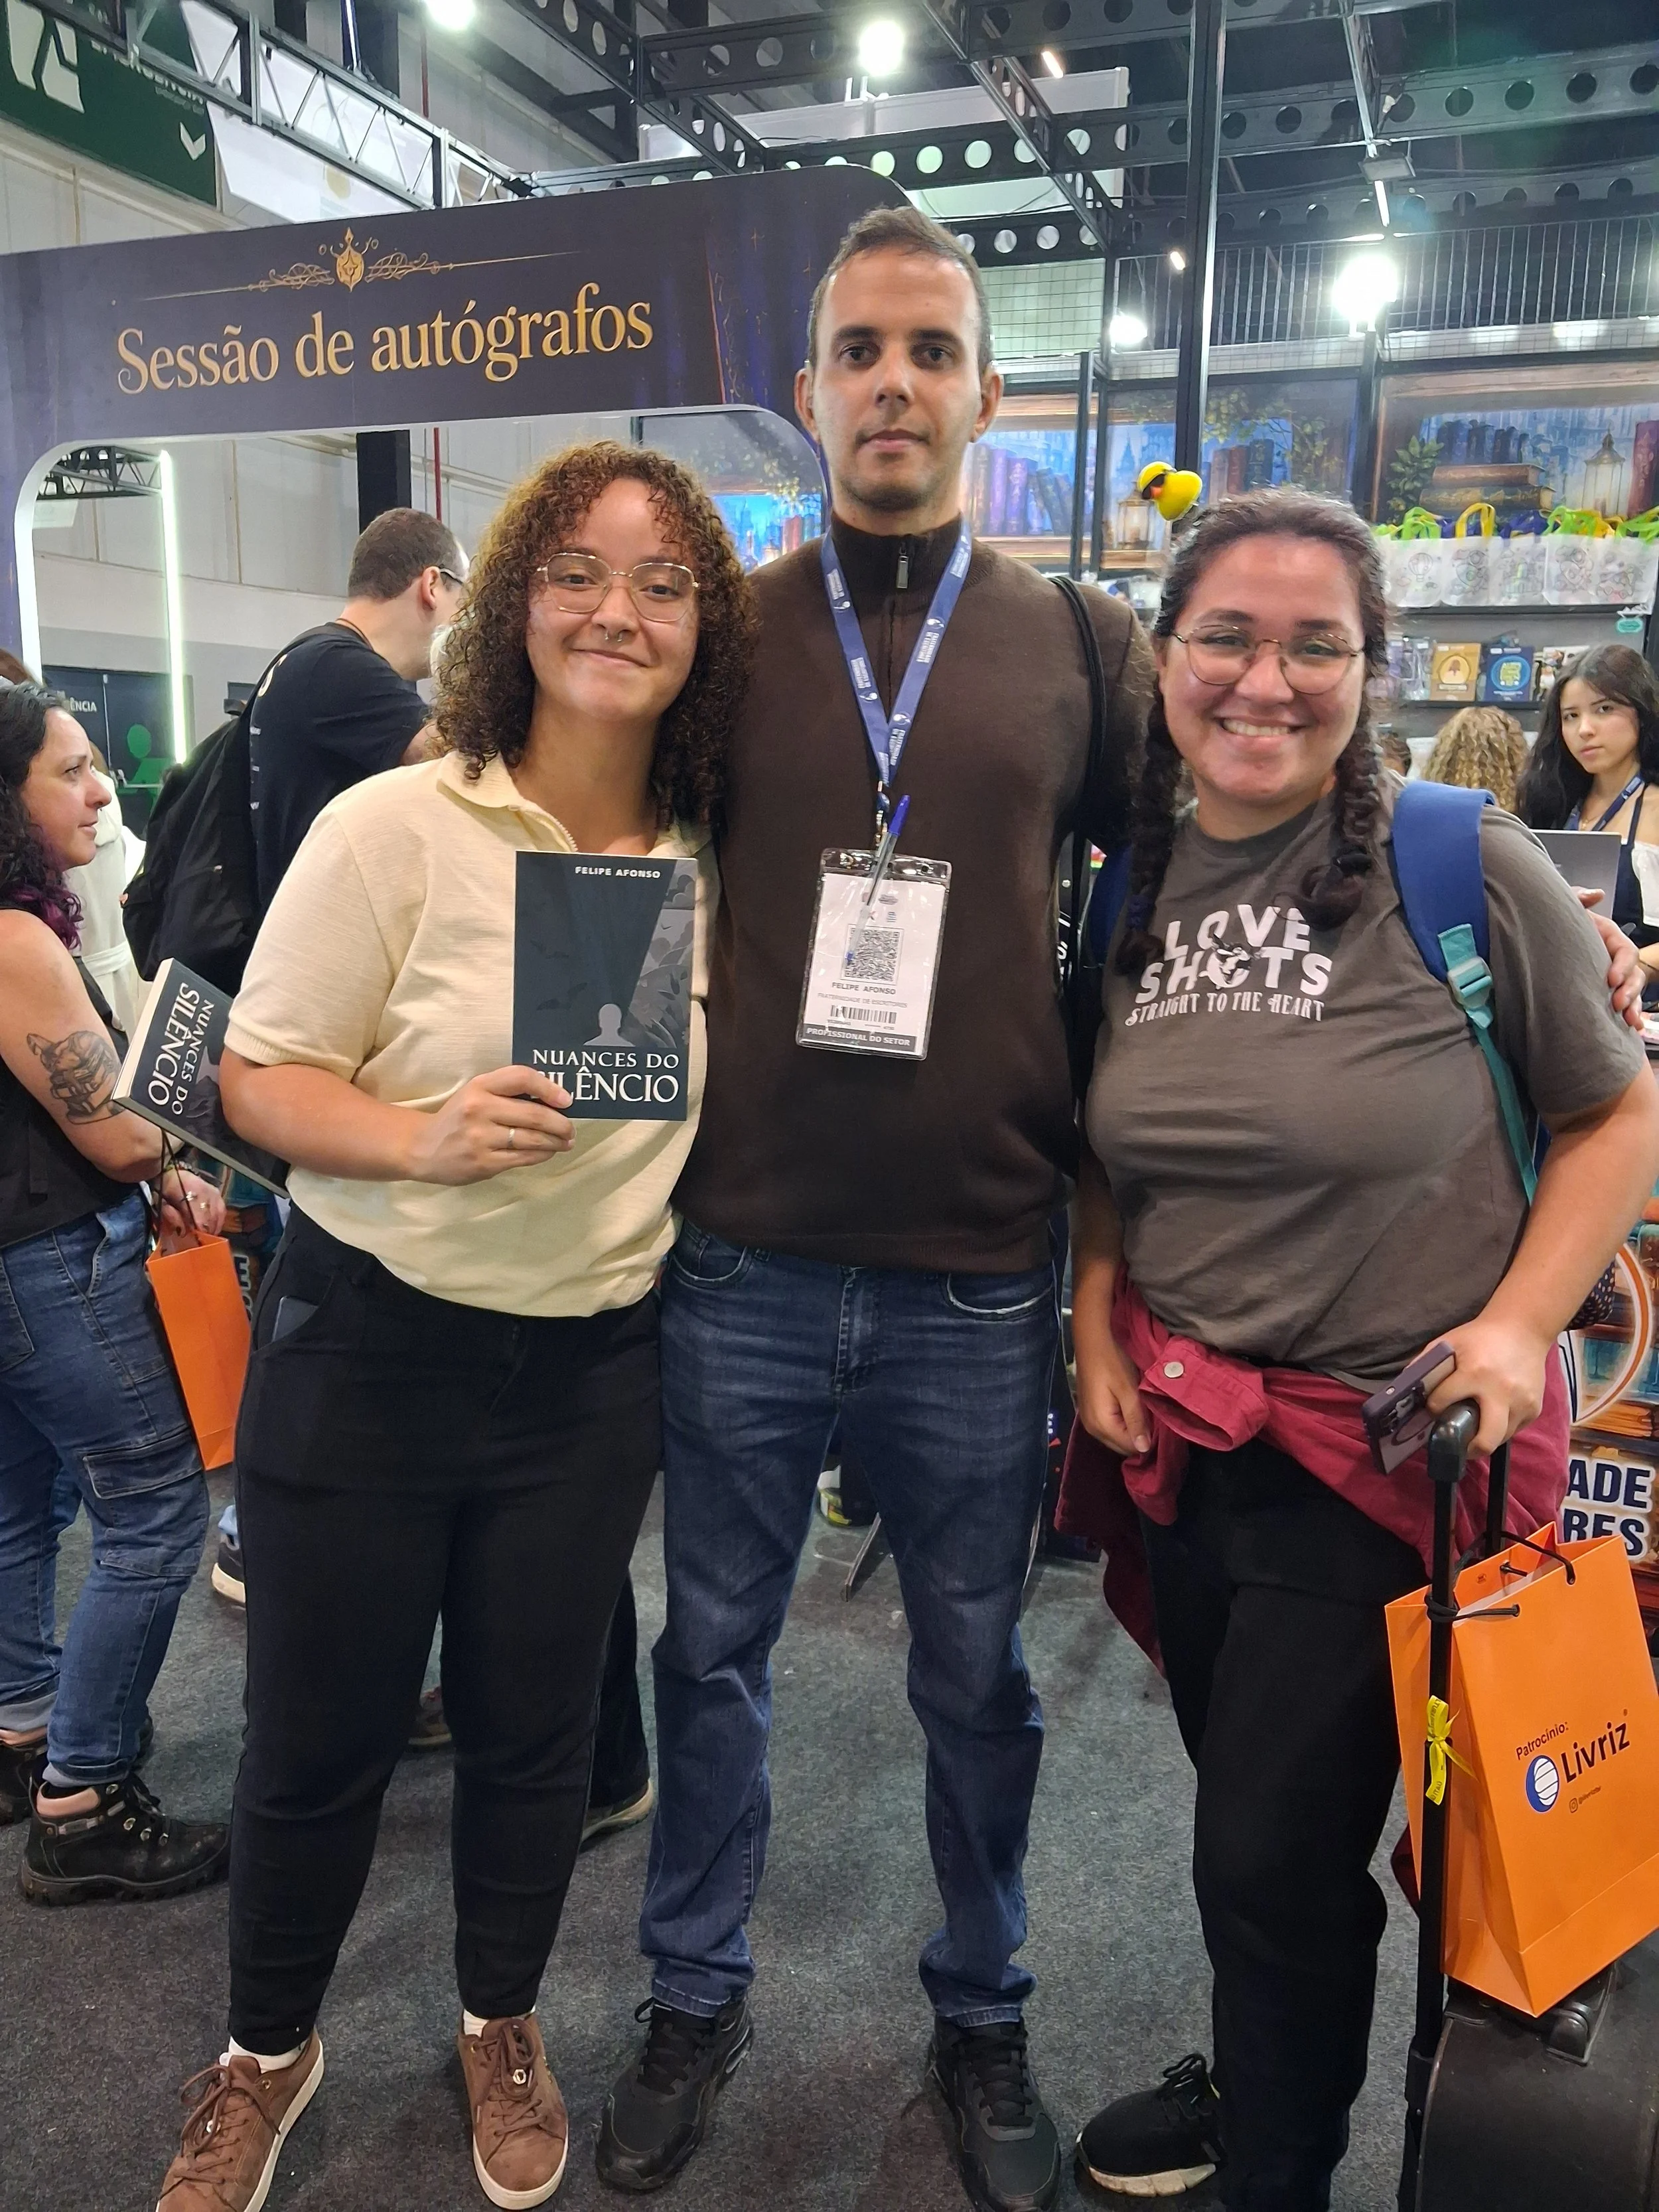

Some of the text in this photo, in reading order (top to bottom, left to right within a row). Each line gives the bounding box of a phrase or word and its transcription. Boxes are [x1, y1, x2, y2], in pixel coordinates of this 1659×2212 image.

[118, 282, 654, 394] Sessão de autógrafos
[575, 866, 661, 879] FELIPE AFONSO
[1163, 903, 1311, 962] LOVE
[831, 982, 897, 995] FELIPE AFONSO
[1125, 992, 1325, 1027] STRAIGHT TO THE HEART
[147, 982, 200, 1106] SILÊNCIO
[171, 999, 214, 1115] NUANCES DO
[806, 1027, 868, 1042] PROFISSIONAL
[883, 1037, 910, 1047] SETOR
[533, 1049, 680, 1069] NUANCES DO
[1516, 1721, 1569, 1761] Patrocínio:
[1561, 1722, 1630, 1783] Livriz
